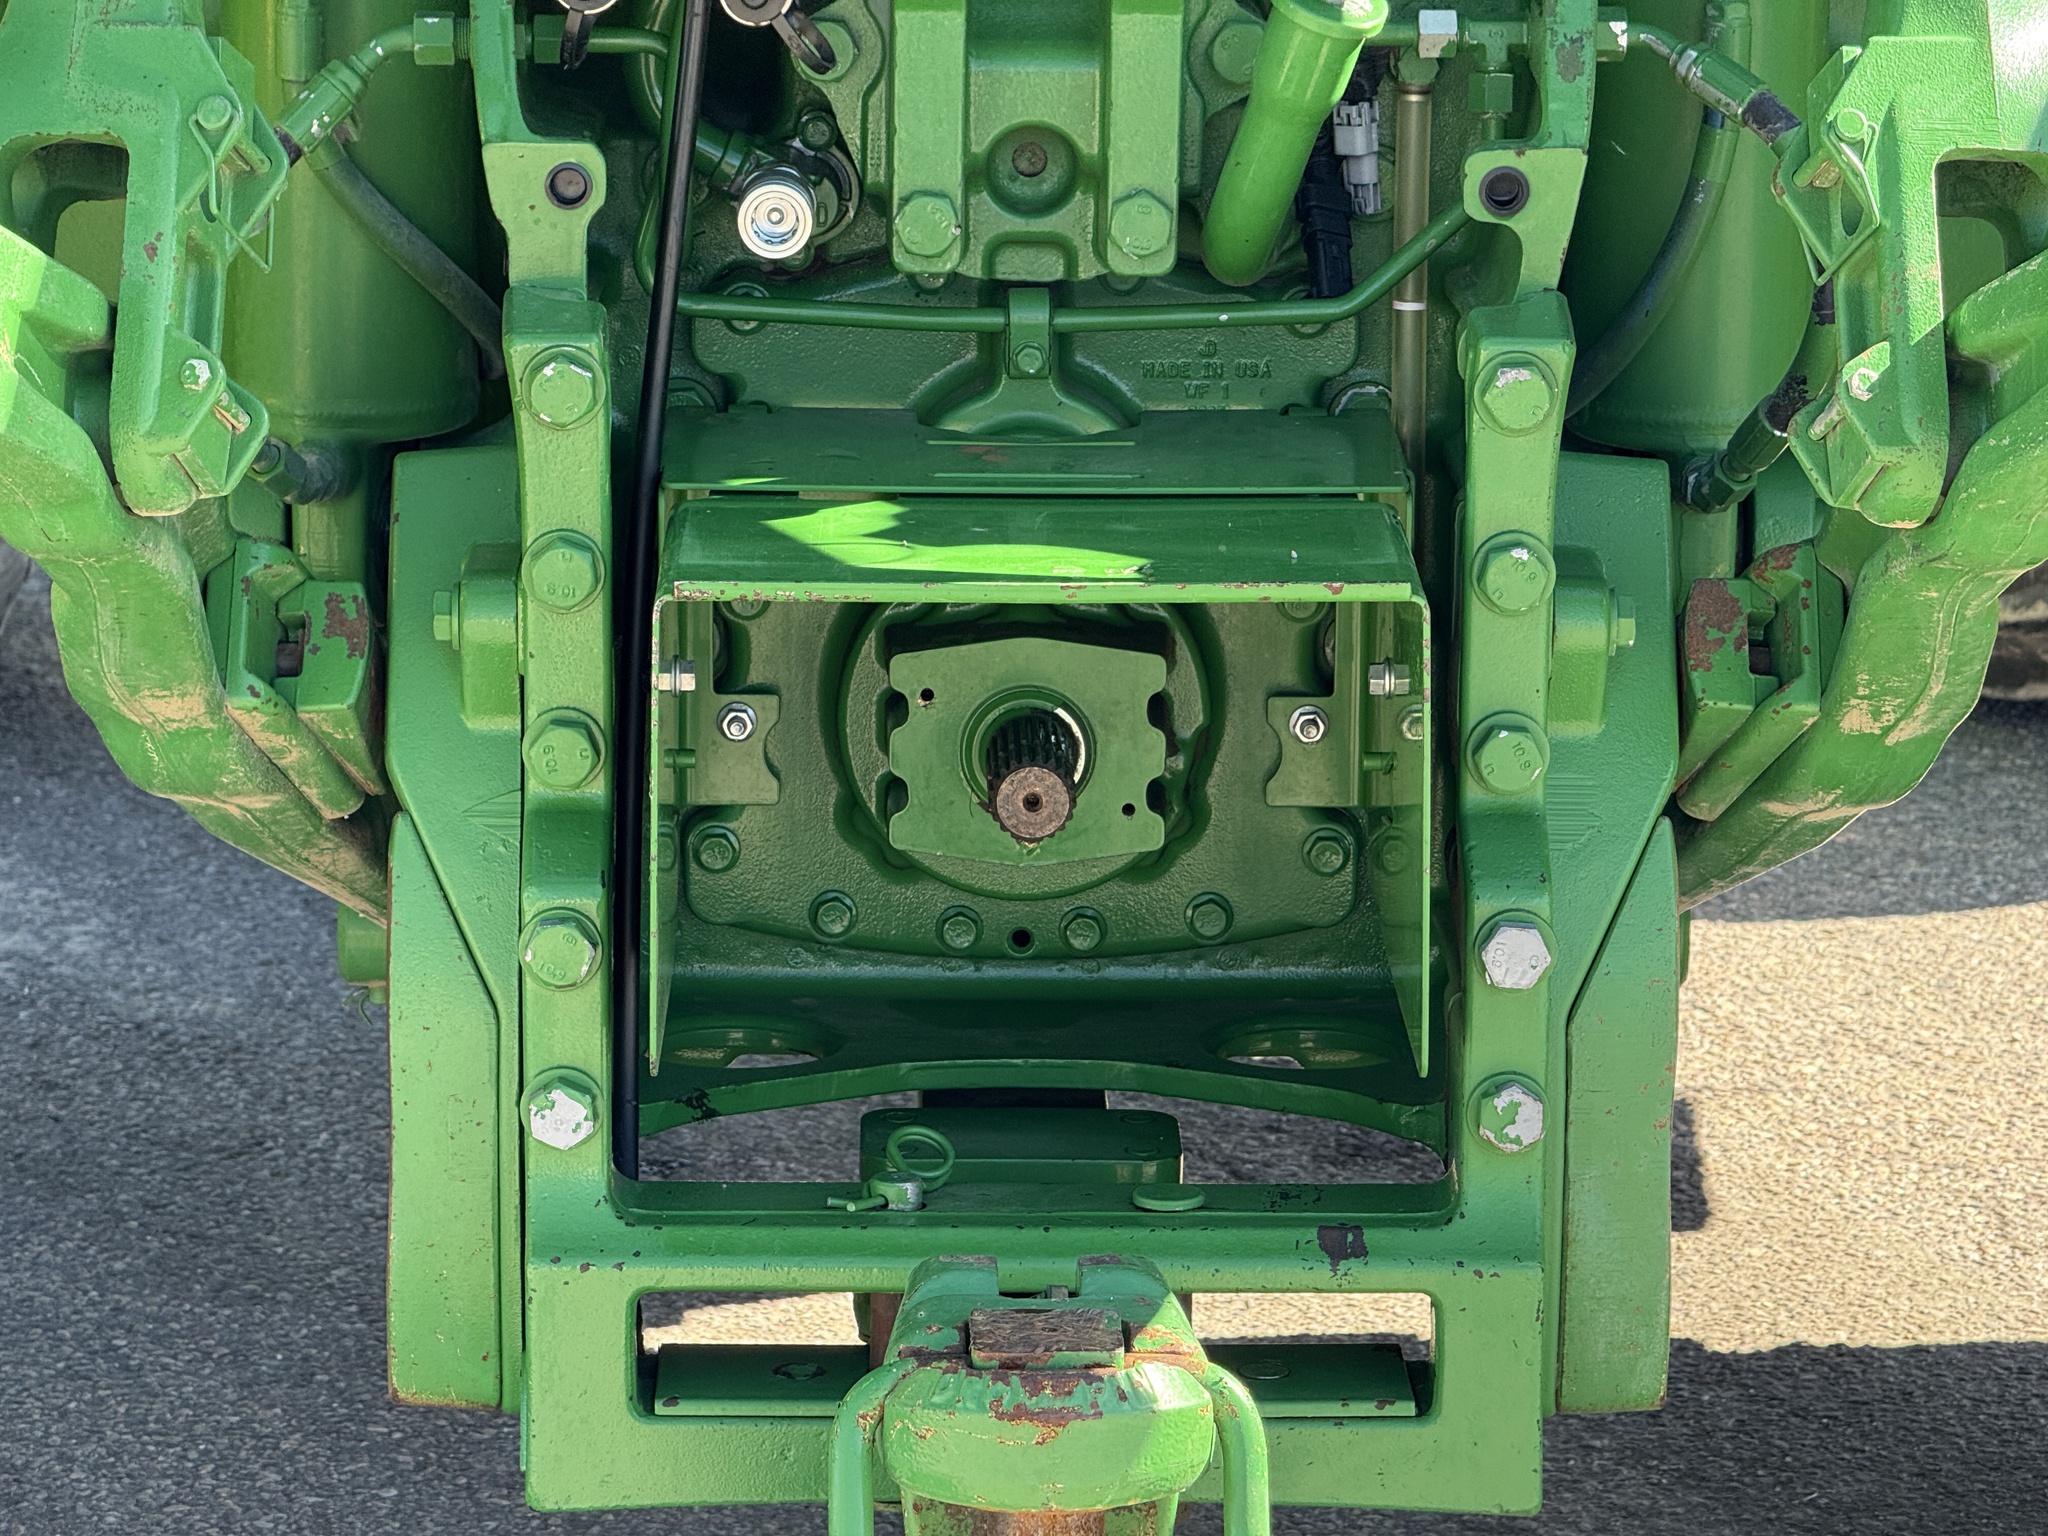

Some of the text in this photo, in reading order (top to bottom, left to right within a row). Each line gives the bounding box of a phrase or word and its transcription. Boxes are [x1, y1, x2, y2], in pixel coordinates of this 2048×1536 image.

[1141, 359, 1272, 378] MADE IN USA
[1184, 381, 1210, 400] WF
[541, 744, 558, 775] 10.9
[1512, 741, 1531, 771] 10.9
[538, 961, 566, 980] 10.9
